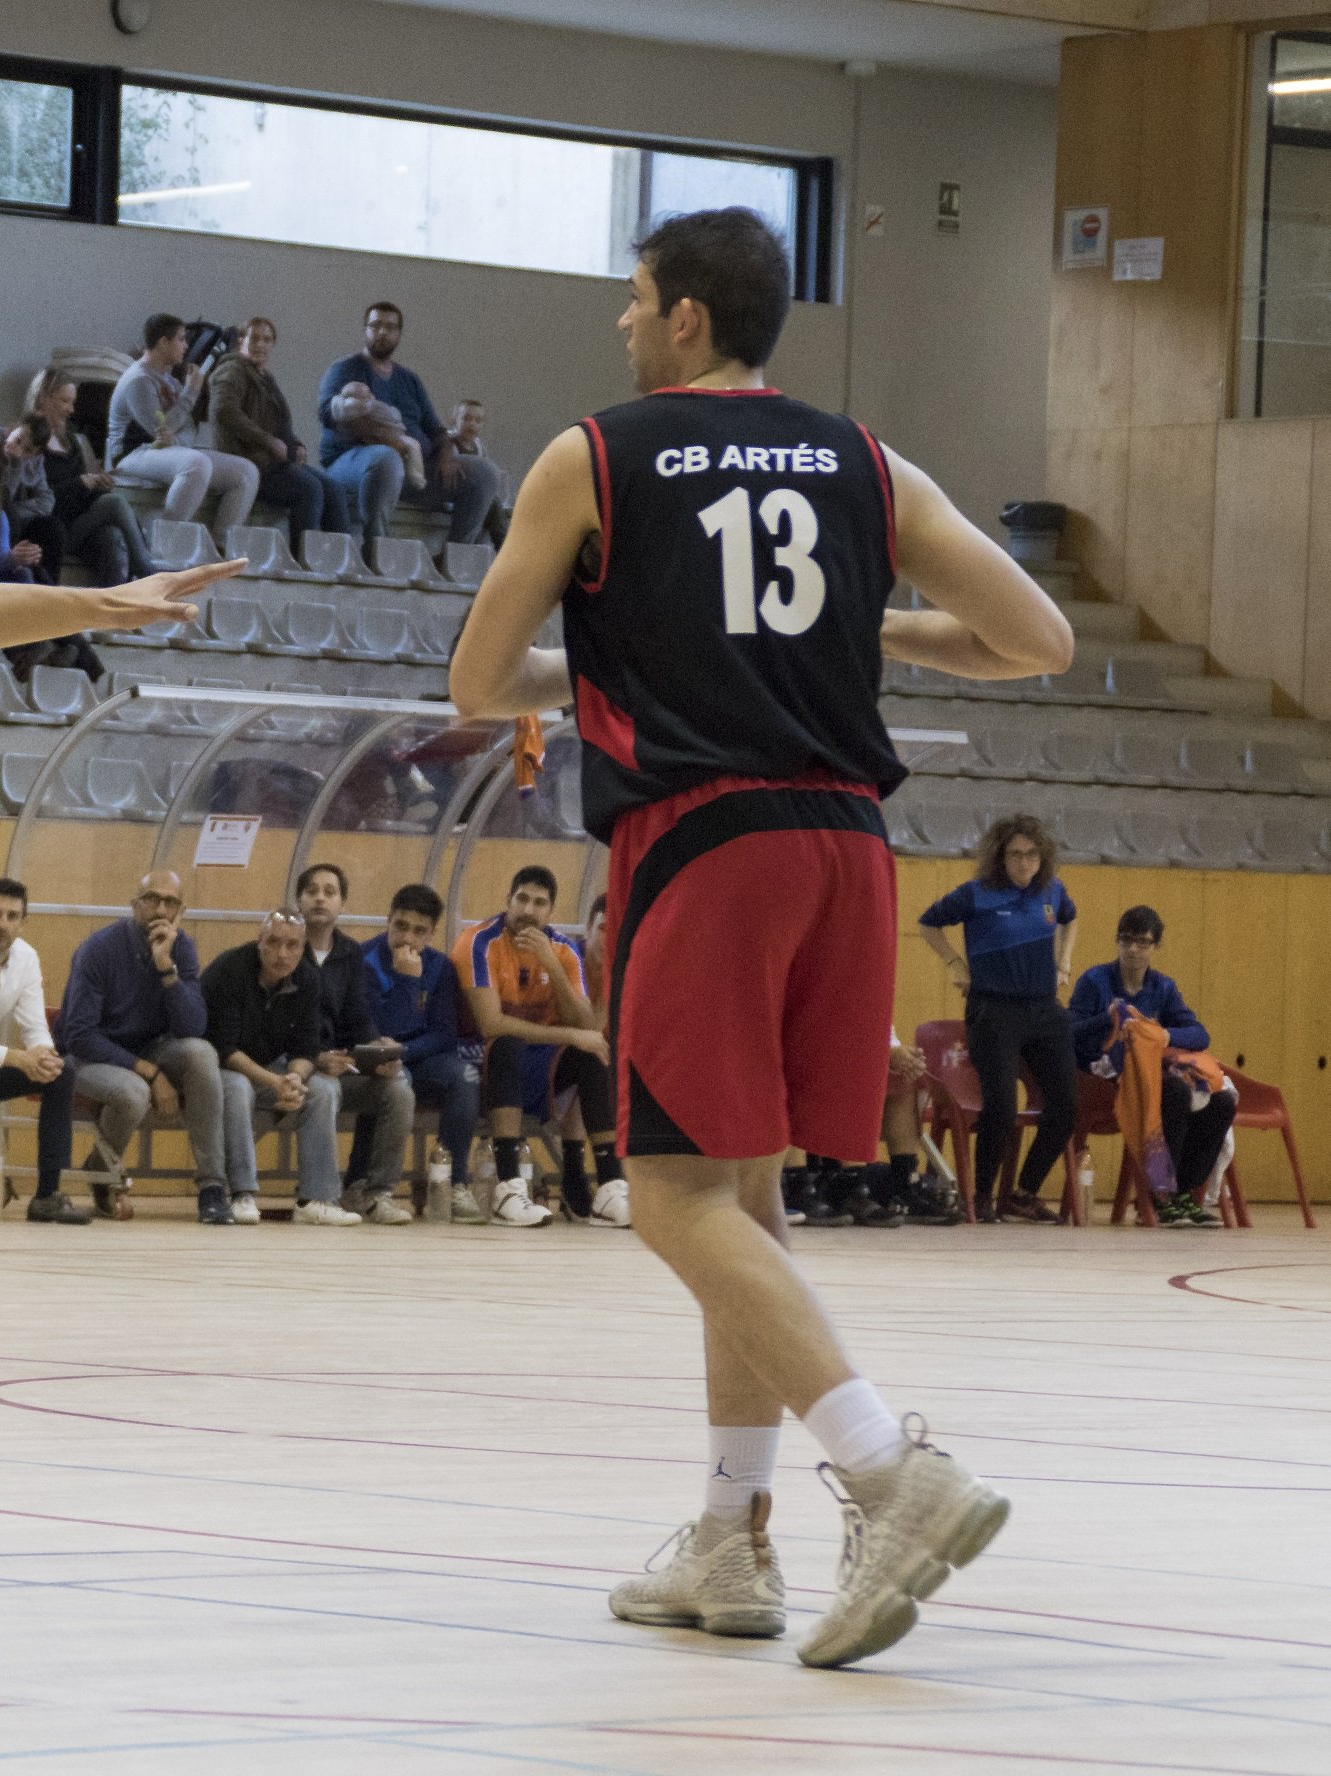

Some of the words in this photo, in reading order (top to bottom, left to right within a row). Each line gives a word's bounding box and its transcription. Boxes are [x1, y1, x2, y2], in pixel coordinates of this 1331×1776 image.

[655, 445, 710, 477] CB
[719, 443, 839, 473] ARTÉS
[697, 486, 826, 636] 13
